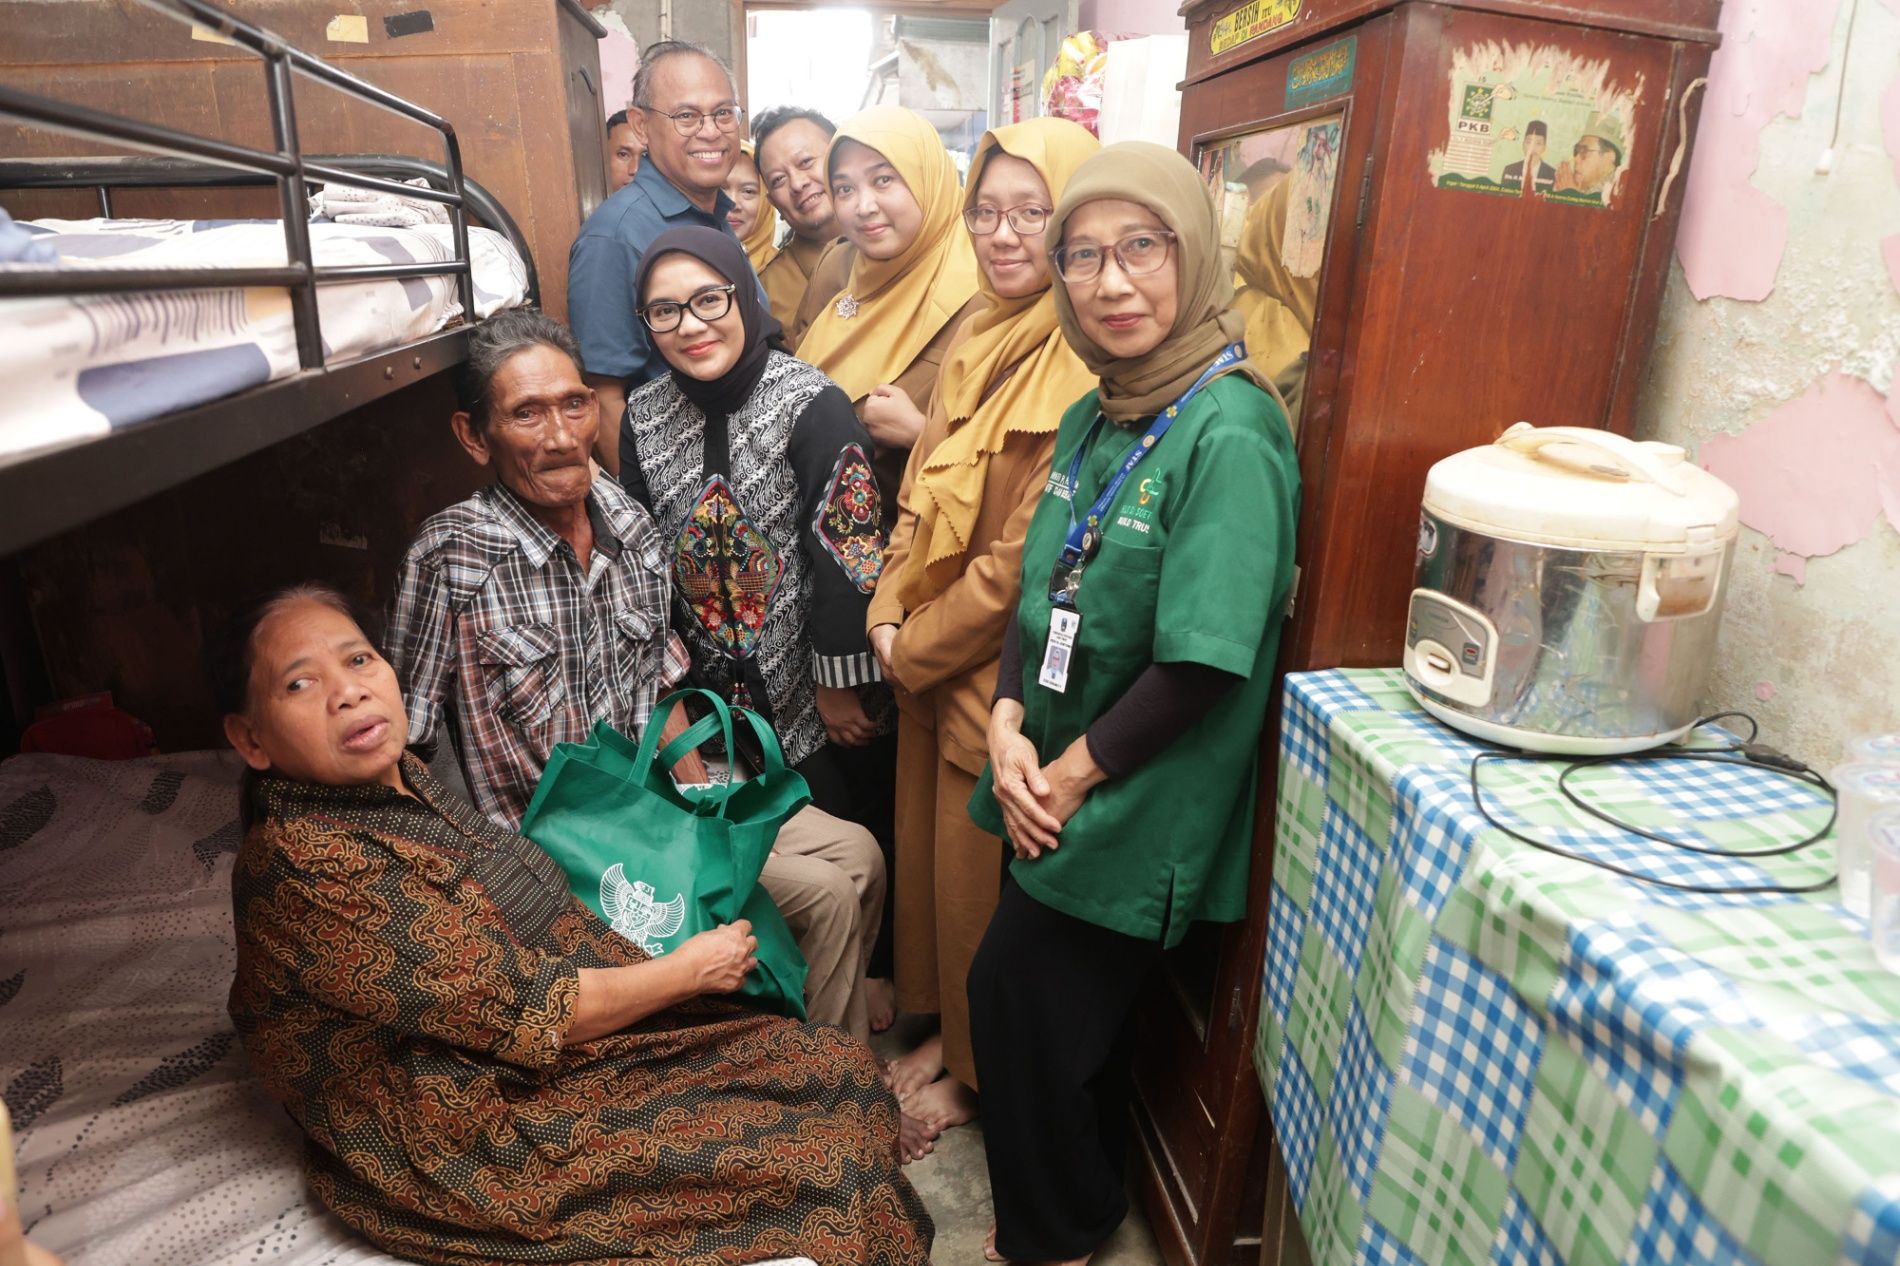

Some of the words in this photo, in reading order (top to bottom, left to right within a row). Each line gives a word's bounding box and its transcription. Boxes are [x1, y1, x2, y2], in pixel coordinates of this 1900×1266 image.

[1234, 1, 1260, 32] BERSIH
[1261, 5, 1273, 19] ITU
[1458, 121, 1490, 133] PKB
